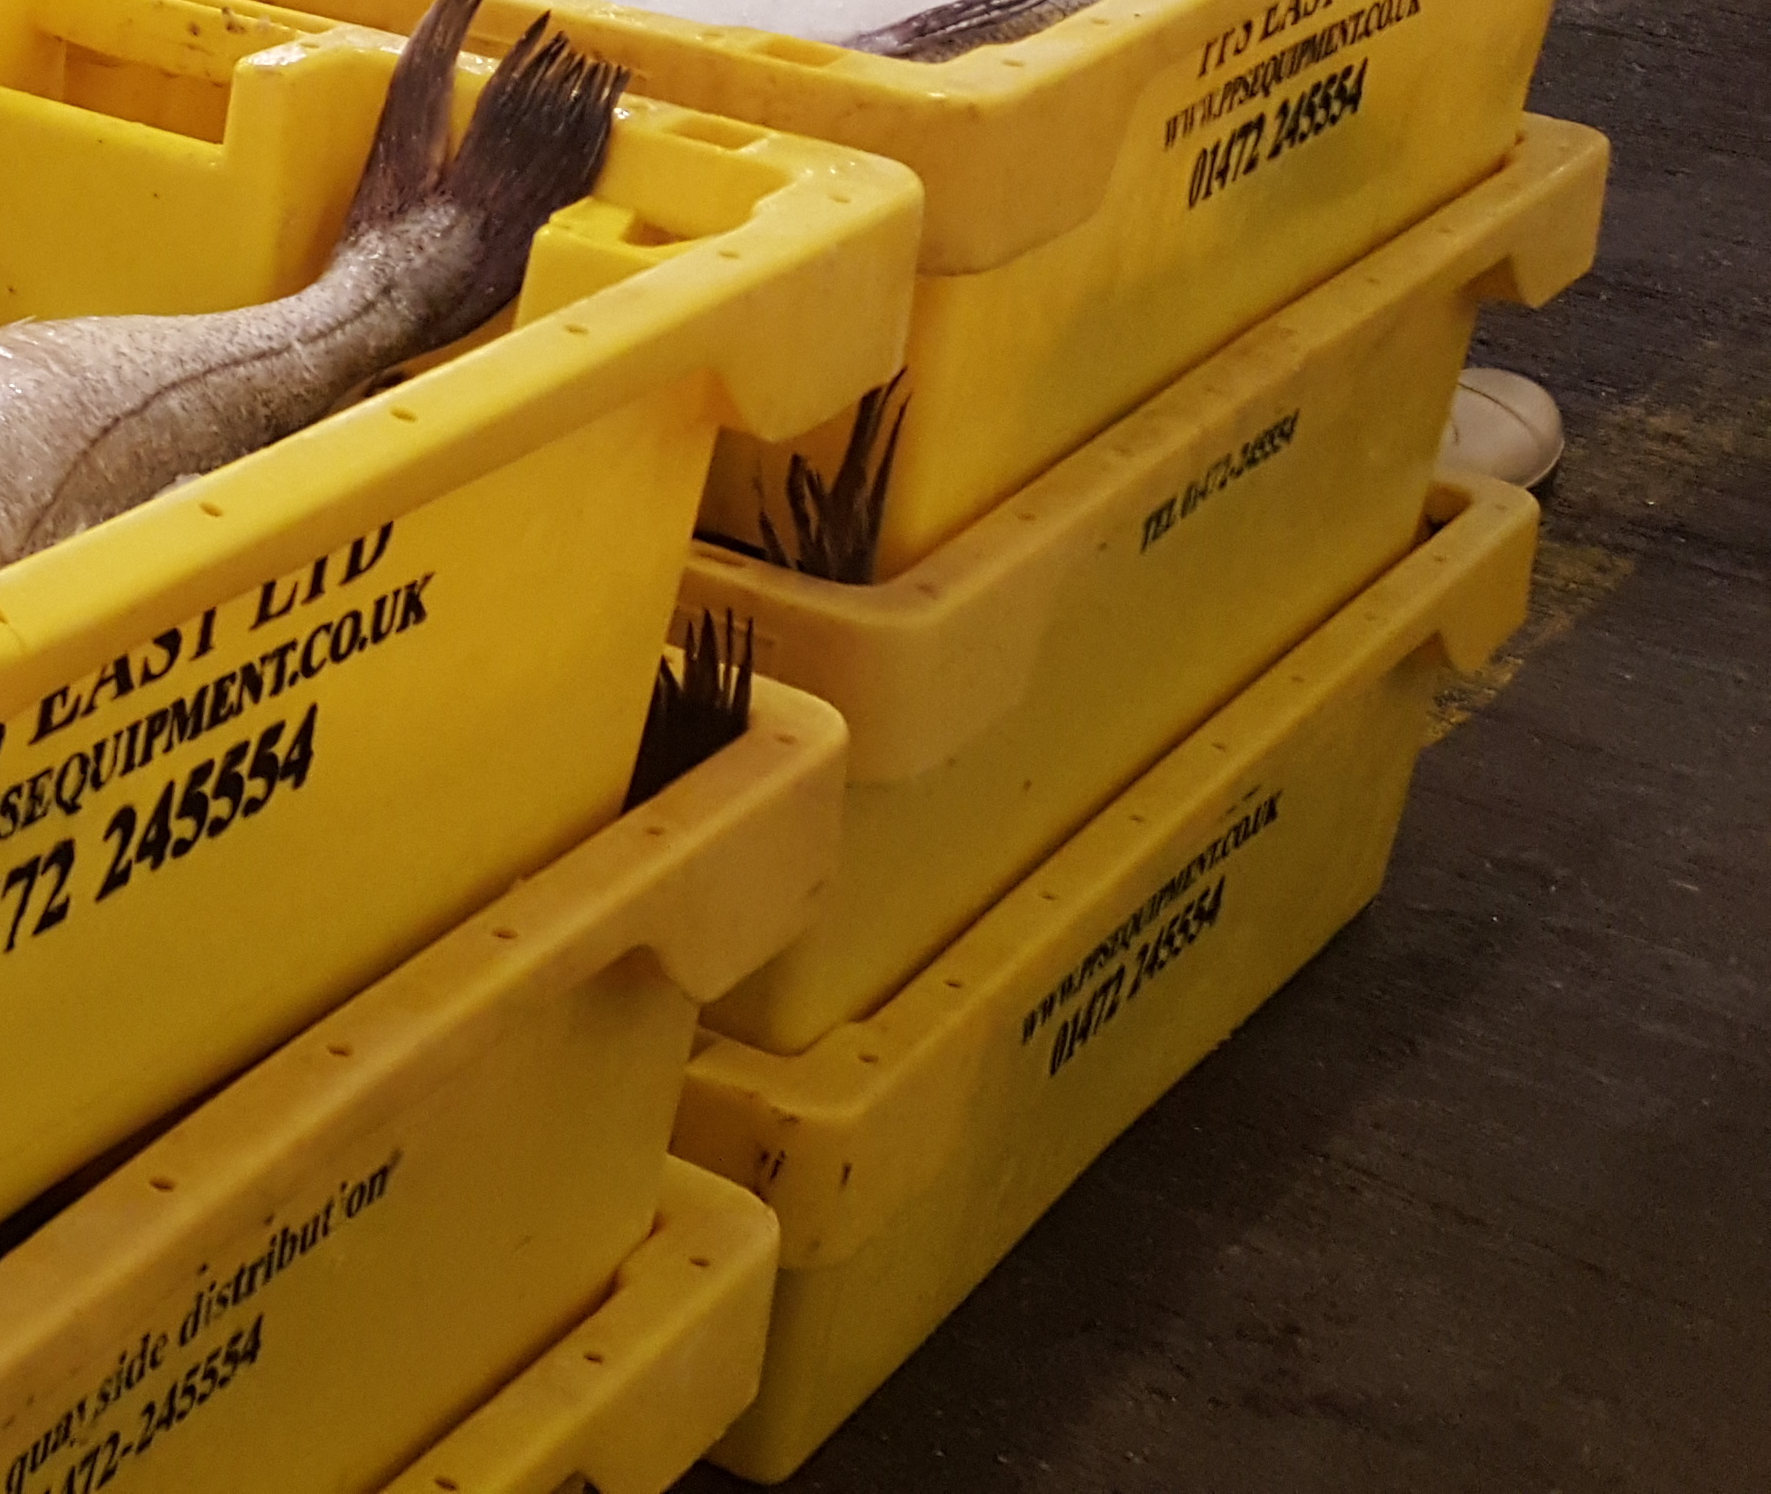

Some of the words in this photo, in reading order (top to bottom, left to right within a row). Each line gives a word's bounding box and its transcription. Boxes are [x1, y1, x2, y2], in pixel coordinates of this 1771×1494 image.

[1189, 110, 1266, 209] 01472
[1267, 56, 1369, 160] 245554
[94, 702, 319, 904] 245554
